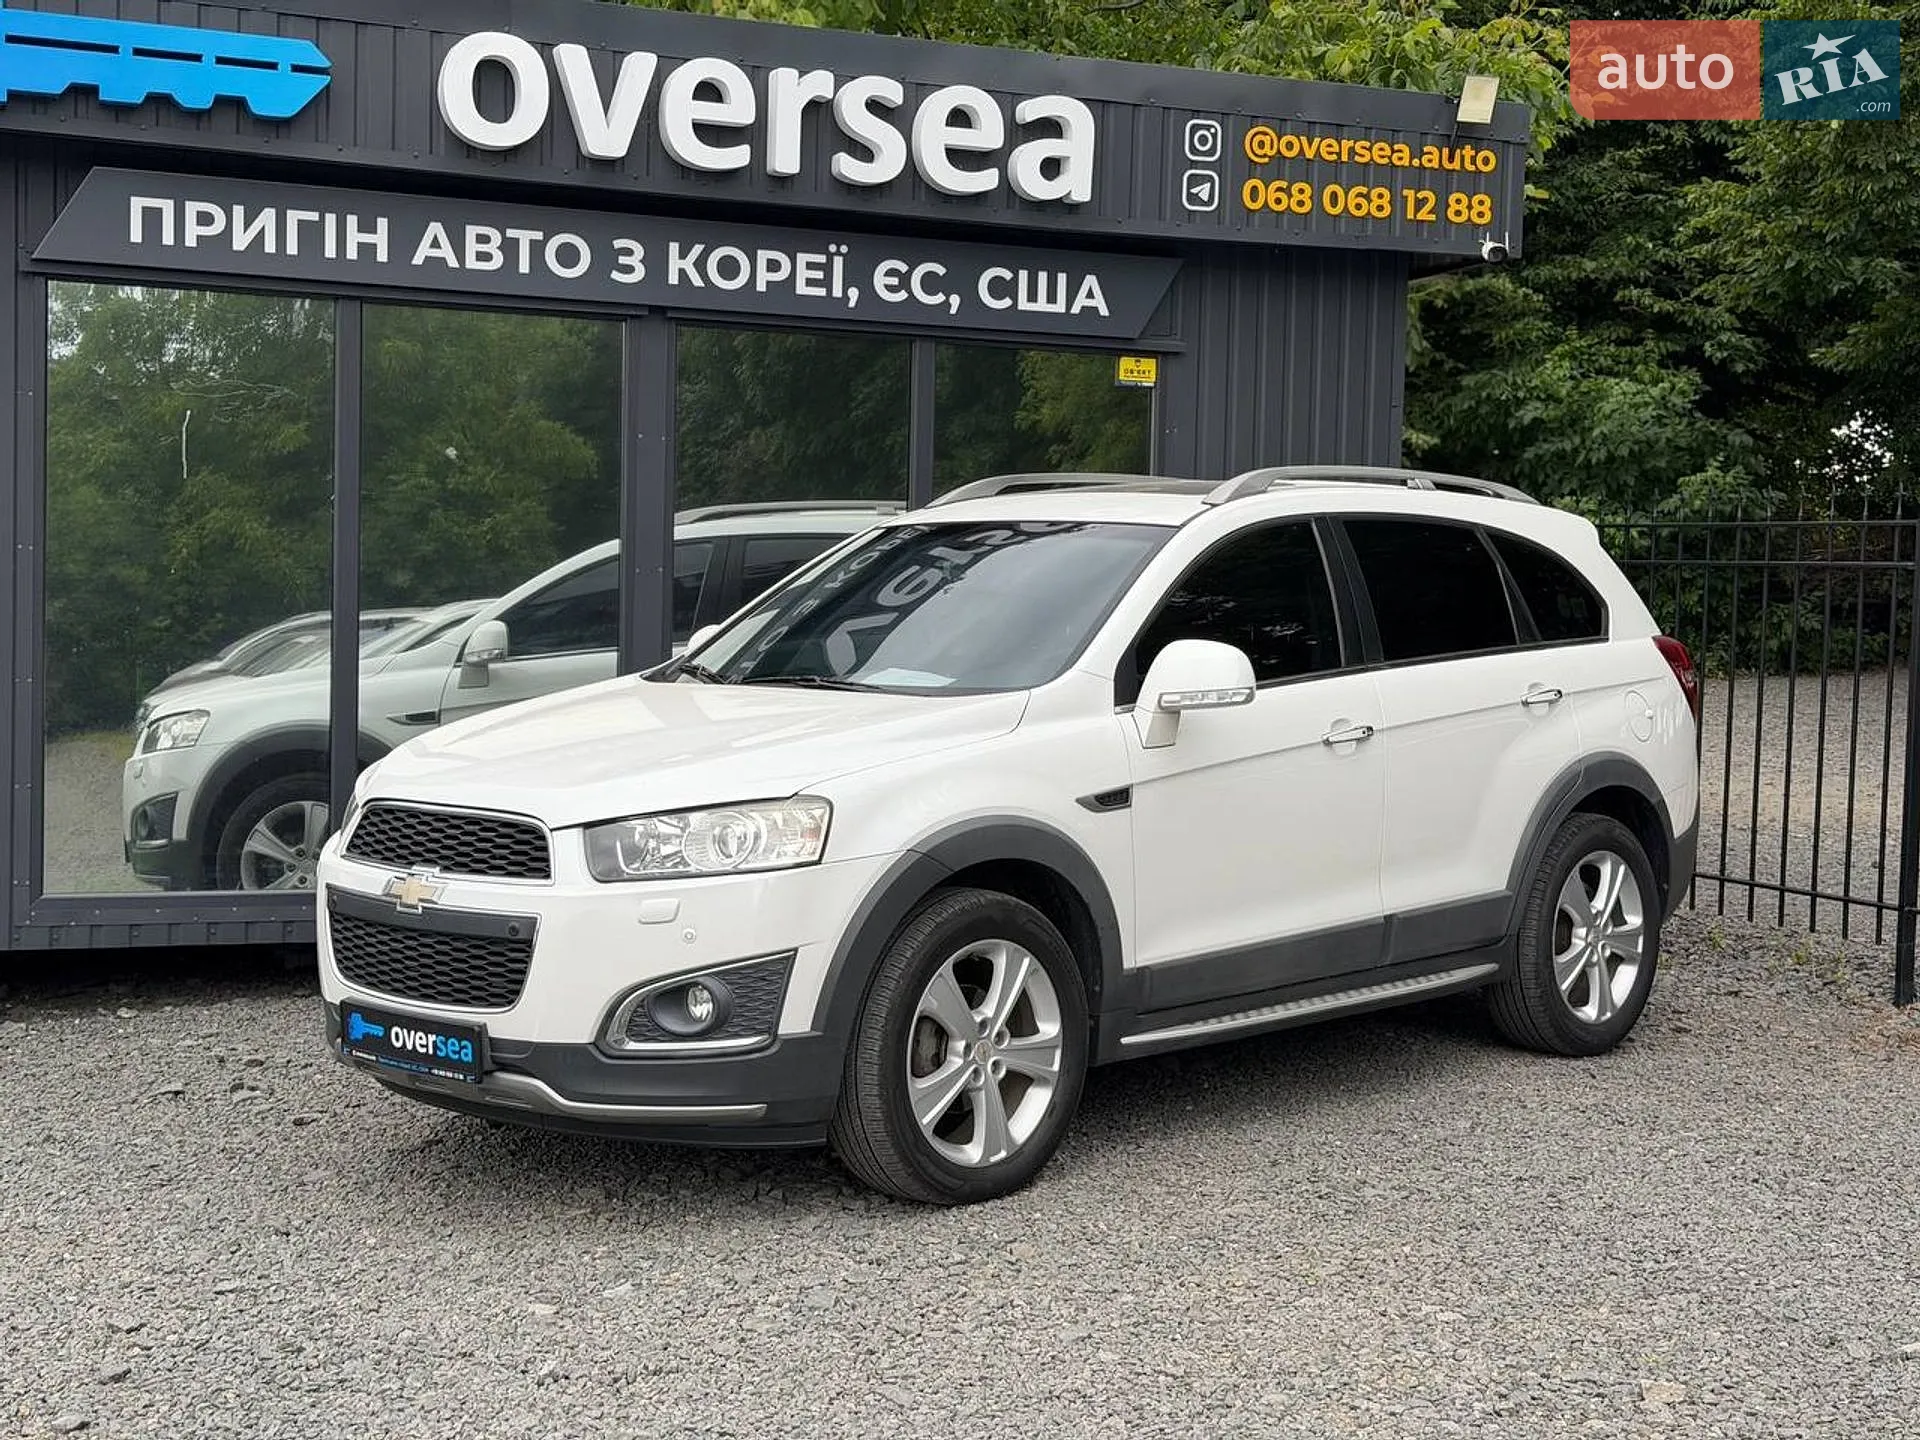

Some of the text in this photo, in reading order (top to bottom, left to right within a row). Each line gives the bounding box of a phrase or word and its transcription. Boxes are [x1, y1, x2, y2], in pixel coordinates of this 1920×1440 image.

[437, 31, 1096, 203] oversea
[1243, 125, 1498, 174] @oversea.auto
[1242, 178, 1493, 225] 068 068 12 88
[129, 195, 1110, 317] ПРИГІН АВТО З КОРЕЇ, ЄС, США
[390, 1026, 473, 1063] oversea
